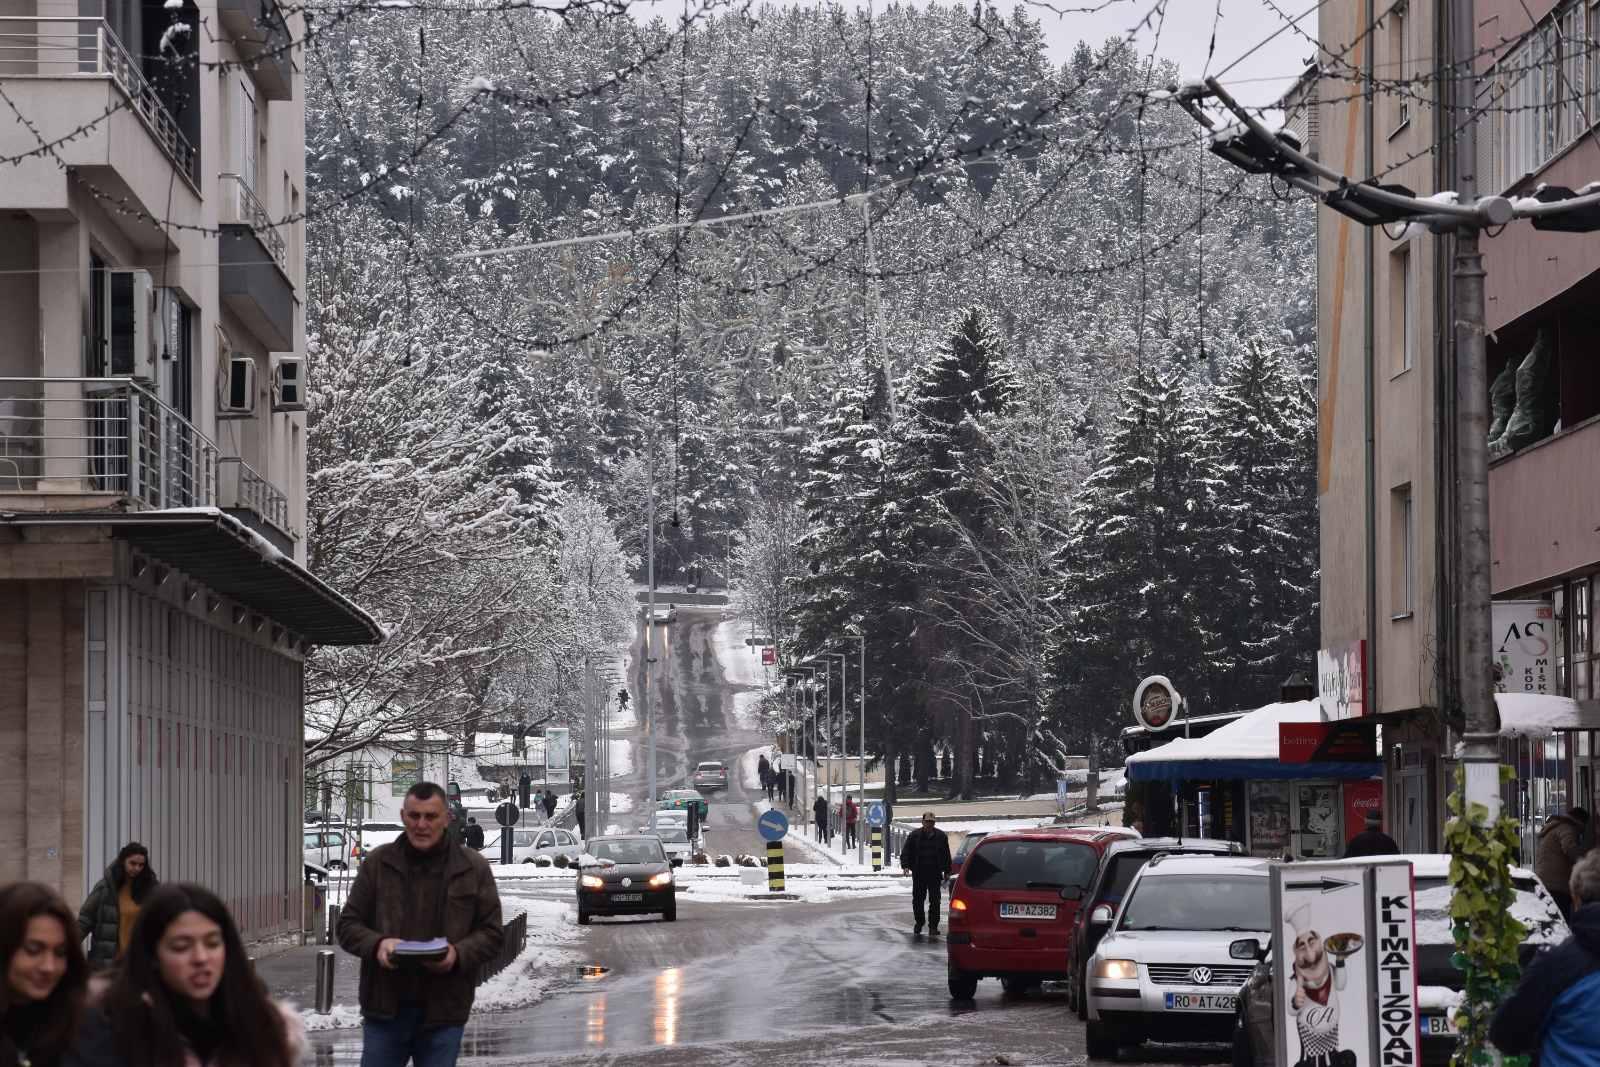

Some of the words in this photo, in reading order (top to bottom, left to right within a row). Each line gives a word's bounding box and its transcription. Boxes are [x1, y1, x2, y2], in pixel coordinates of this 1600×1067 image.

[1496, 621, 1549, 657] AS
[1524, 667, 1534, 691] KOD
[1008, 905, 1019, 915] BA
[1380, 896, 1413, 1067] KLIMATIZOVAN
[1175, 995, 1190, 1008] RO
[1430, 1018, 1450, 1033] BA
